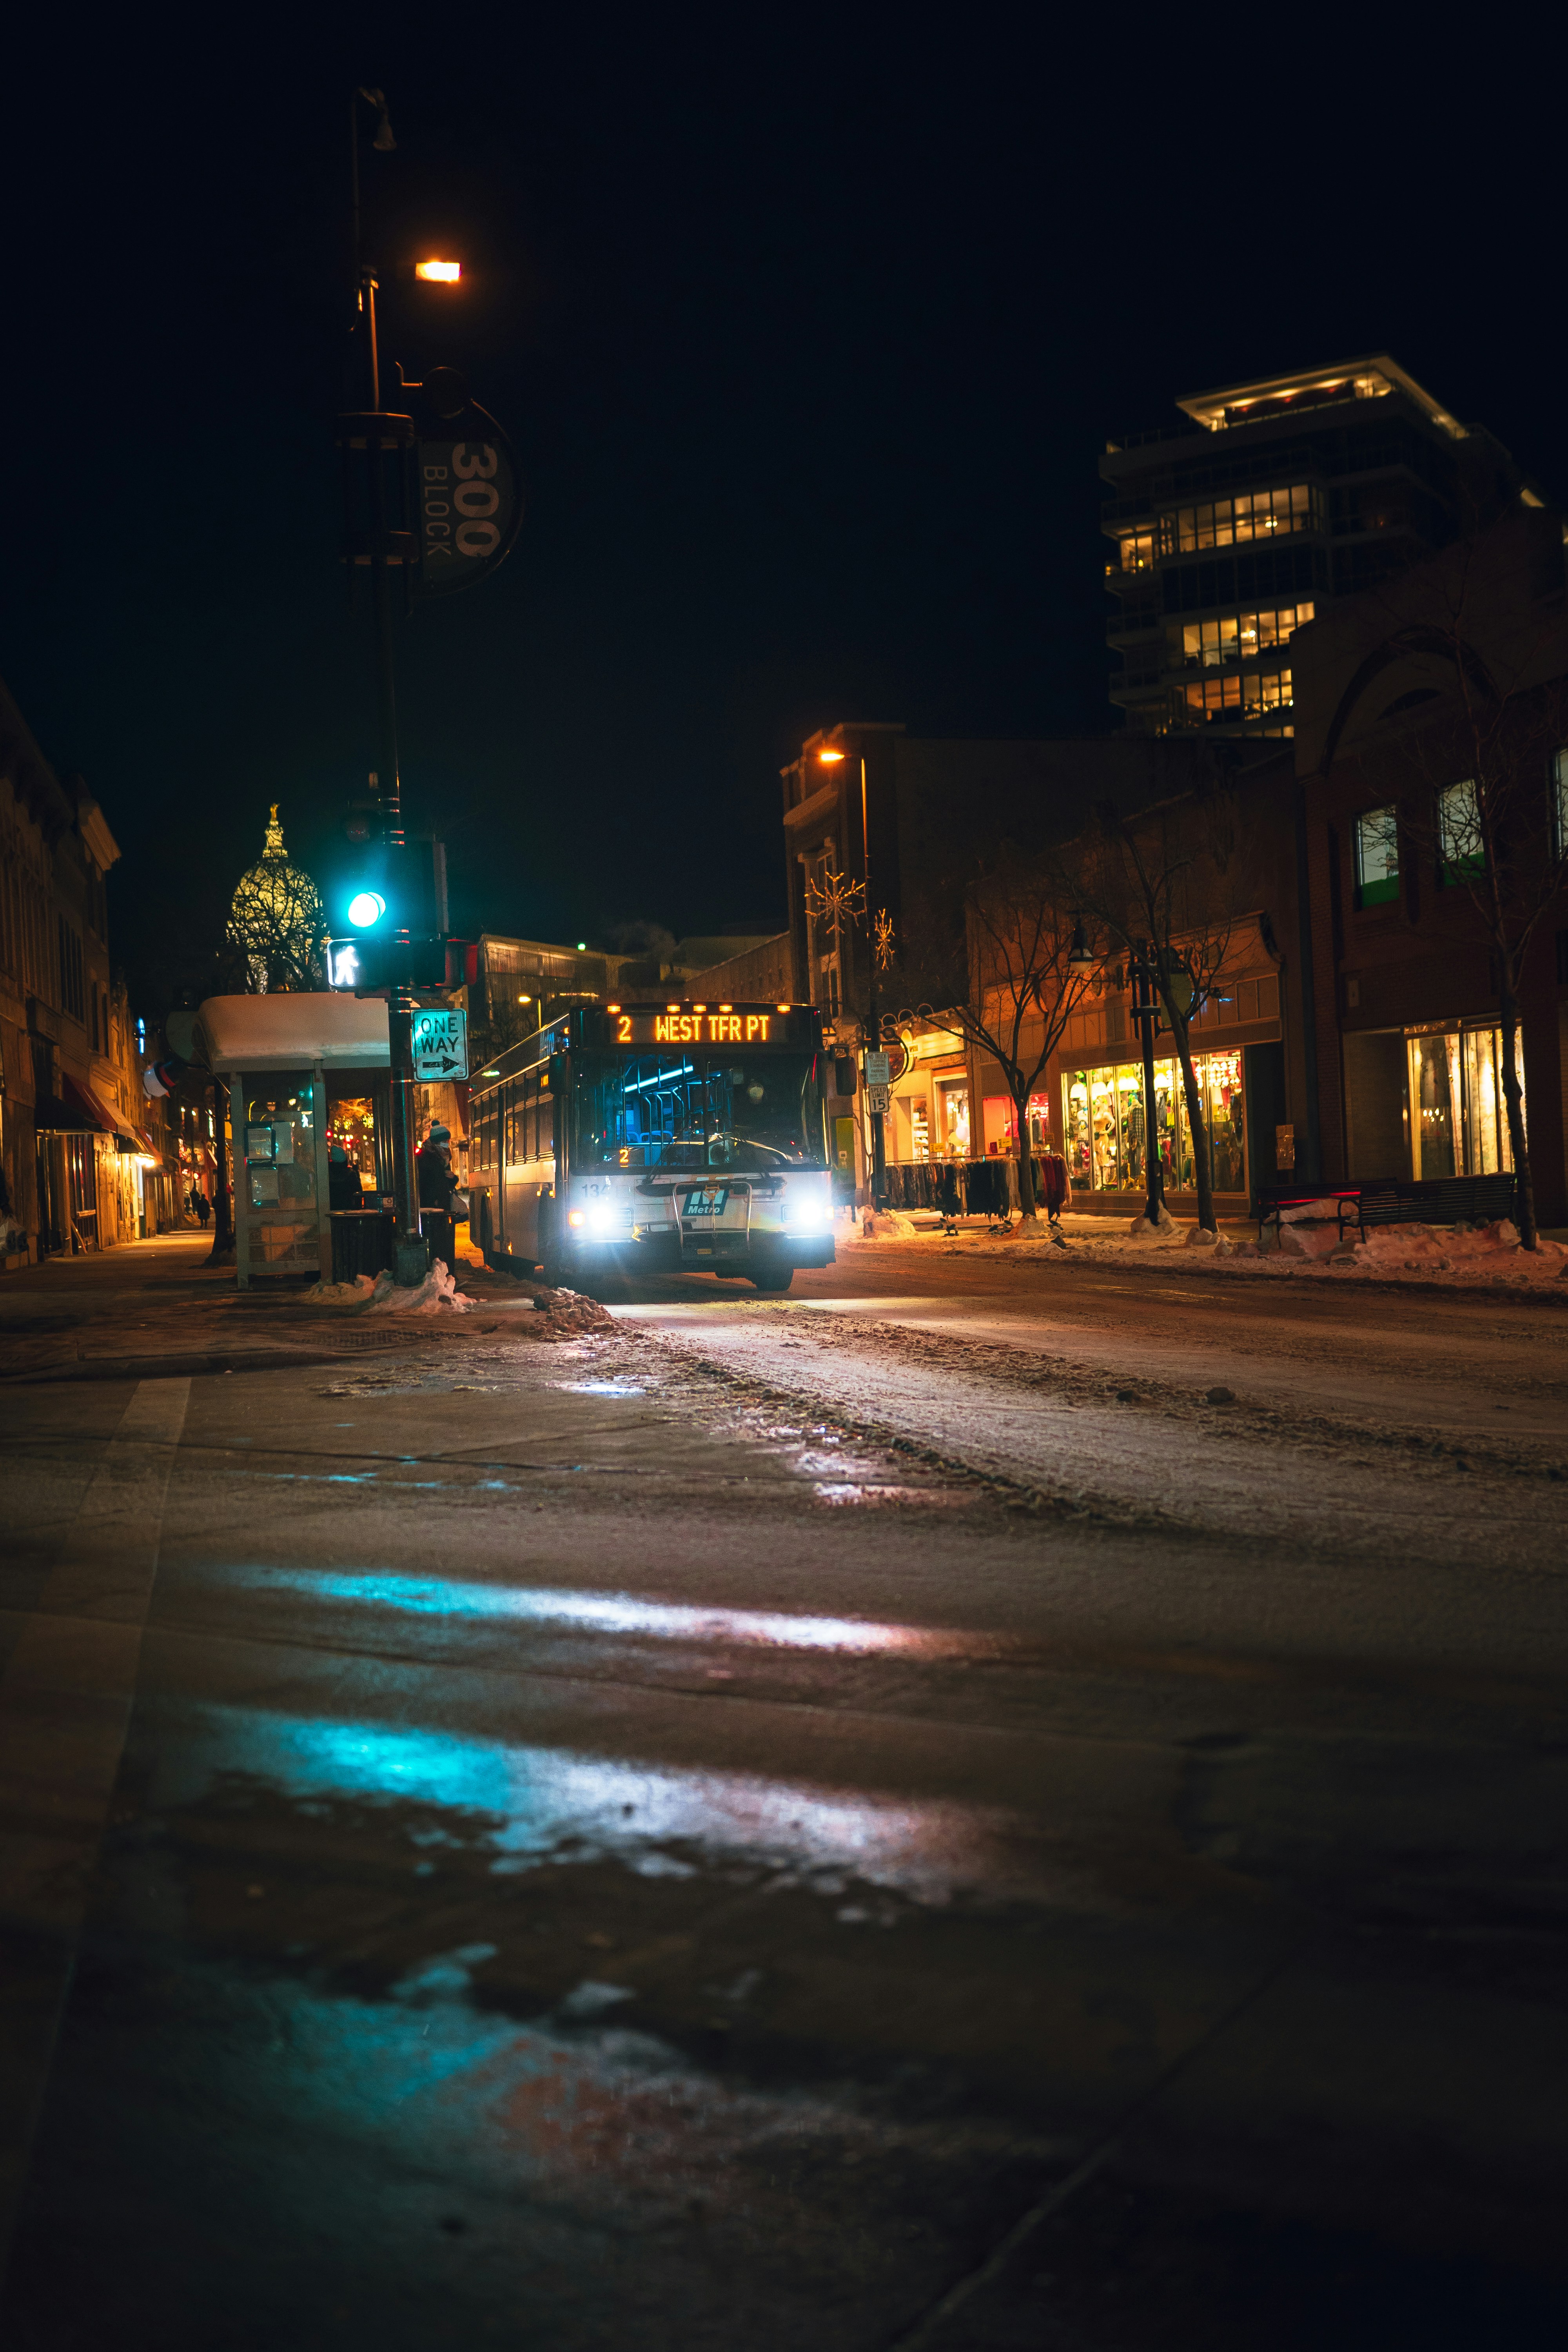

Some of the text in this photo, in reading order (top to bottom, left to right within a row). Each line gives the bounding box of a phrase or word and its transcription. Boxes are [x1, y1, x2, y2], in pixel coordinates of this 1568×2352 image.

[452, 442, 501, 557] 300
[424, 466, 451, 555] BLOCK
[421, 1017, 458, 1034] ONE
[618, 1016, 769, 1041] 2 WEST TFR PT
[421, 1036, 459, 1053] WAY
[873, 1098, 886, 1111] 15
[619, 1149, 629, 1163] 2
[688, 1205, 720, 1214] Metro
